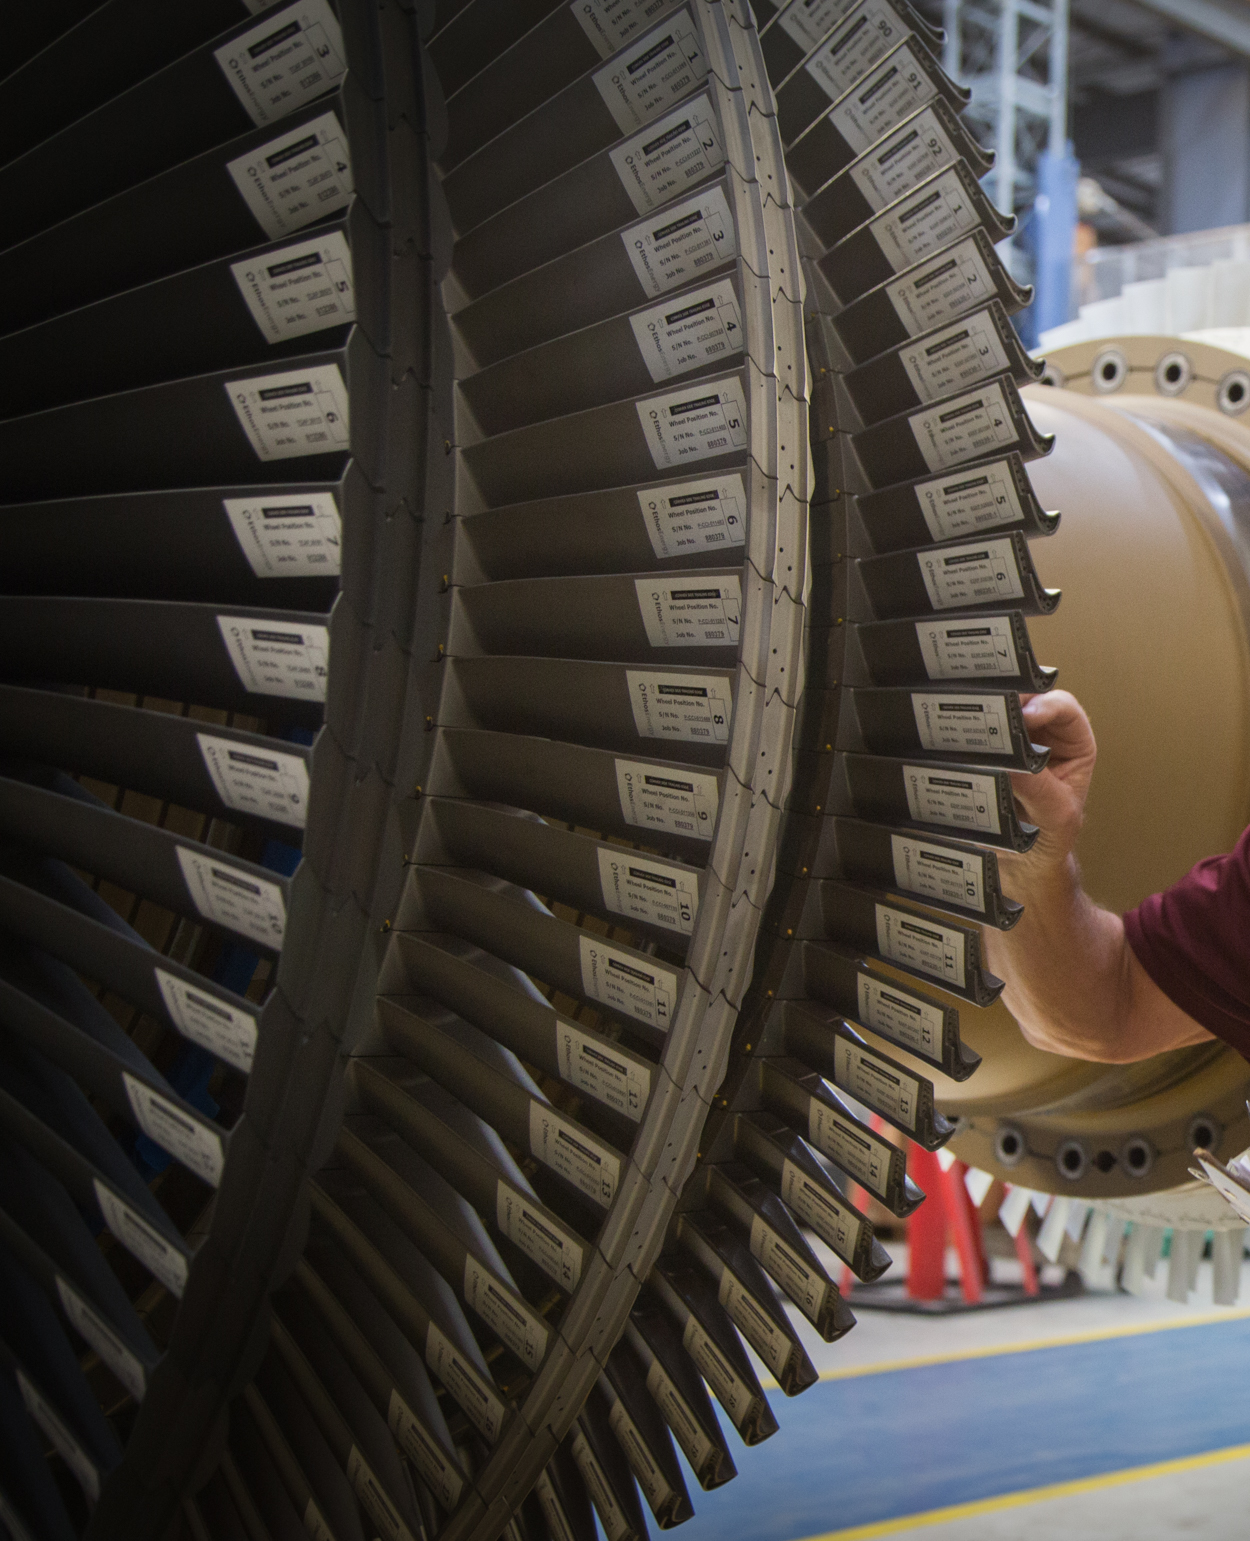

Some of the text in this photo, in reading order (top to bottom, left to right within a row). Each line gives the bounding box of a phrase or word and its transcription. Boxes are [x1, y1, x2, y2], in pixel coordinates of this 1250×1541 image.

[611, 8, 632, 26] S/N No.
[620, 25, 630, 38] Job
[629, 21, 639, 30] No.
[878, 20, 892, 37] 90
[316, 44, 329, 58] 3
[687, 51, 698, 63] 1
[630, 71, 647, 85] Wheel
[644, 57, 667, 74] Position
[665, 52, 676, 61] No.
[907, 73, 921, 91] 91
[637, 88, 648, 98] S/N
[644, 101, 654, 111] Job
[702, 138, 713, 150] 2
[927, 138, 942, 157] 92
[644, 154, 661, 167] Wheel
[660, 142, 682, 157] Position
[337, 161, 347, 173] 4
[650, 170, 662, 180] S/N
[657, 184, 667, 193] Job
[953, 205, 962, 214] 1
[713, 230, 724, 241] 3
[654, 240, 671, 252] Wheel
[671, 231, 692, 244] Position
[659, 257, 671, 266] S/N
[665, 271, 675, 279] Job
[967, 274, 977, 284] 2
[336, 281, 349, 293] 5
[666, 326, 683, 337] Wheel
[683, 319, 705, 330] Position
[727, 322, 736, 331] 4
[671, 342, 682, 351] S/N
[978, 346, 989, 356] 3
[677, 356, 687, 364] Job
[326, 412, 338, 423] 6
[668, 418, 686, 427] Wheel
[686, 413, 708, 423] Position
[728, 418, 740, 428] 5
[994, 419, 1002, 427] 4
[673, 433, 684, 441] S/N
[678, 447, 688, 455] Job
[995, 495, 1006, 504] 5
[667, 510, 684, 518] Wheel
[685, 507, 707, 515] Position
[727, 515, 738, 525] 6
[996, 572, 1006, 580] 6
[728, 616, 738, 625] 7
[997, 649, 1007, 657] 7
[714, 714, 723, 724] 8
[988, 726, 998, 735] 8
[976, 805, 985, 813] 9
[697, 811, 707, 820] 9
[965, 880, 975, 896] 10
[680, 902, 690, 920] 10
[945, 954, 953, 968] 11
[657, 999, 666, 1016] 11
[922, 1027, 930, 1044] 12
[628, 1090, 638, 1109] 12
[901, 1098, 908, 1114] 13
[602, 1179, 611, 1198] 13
